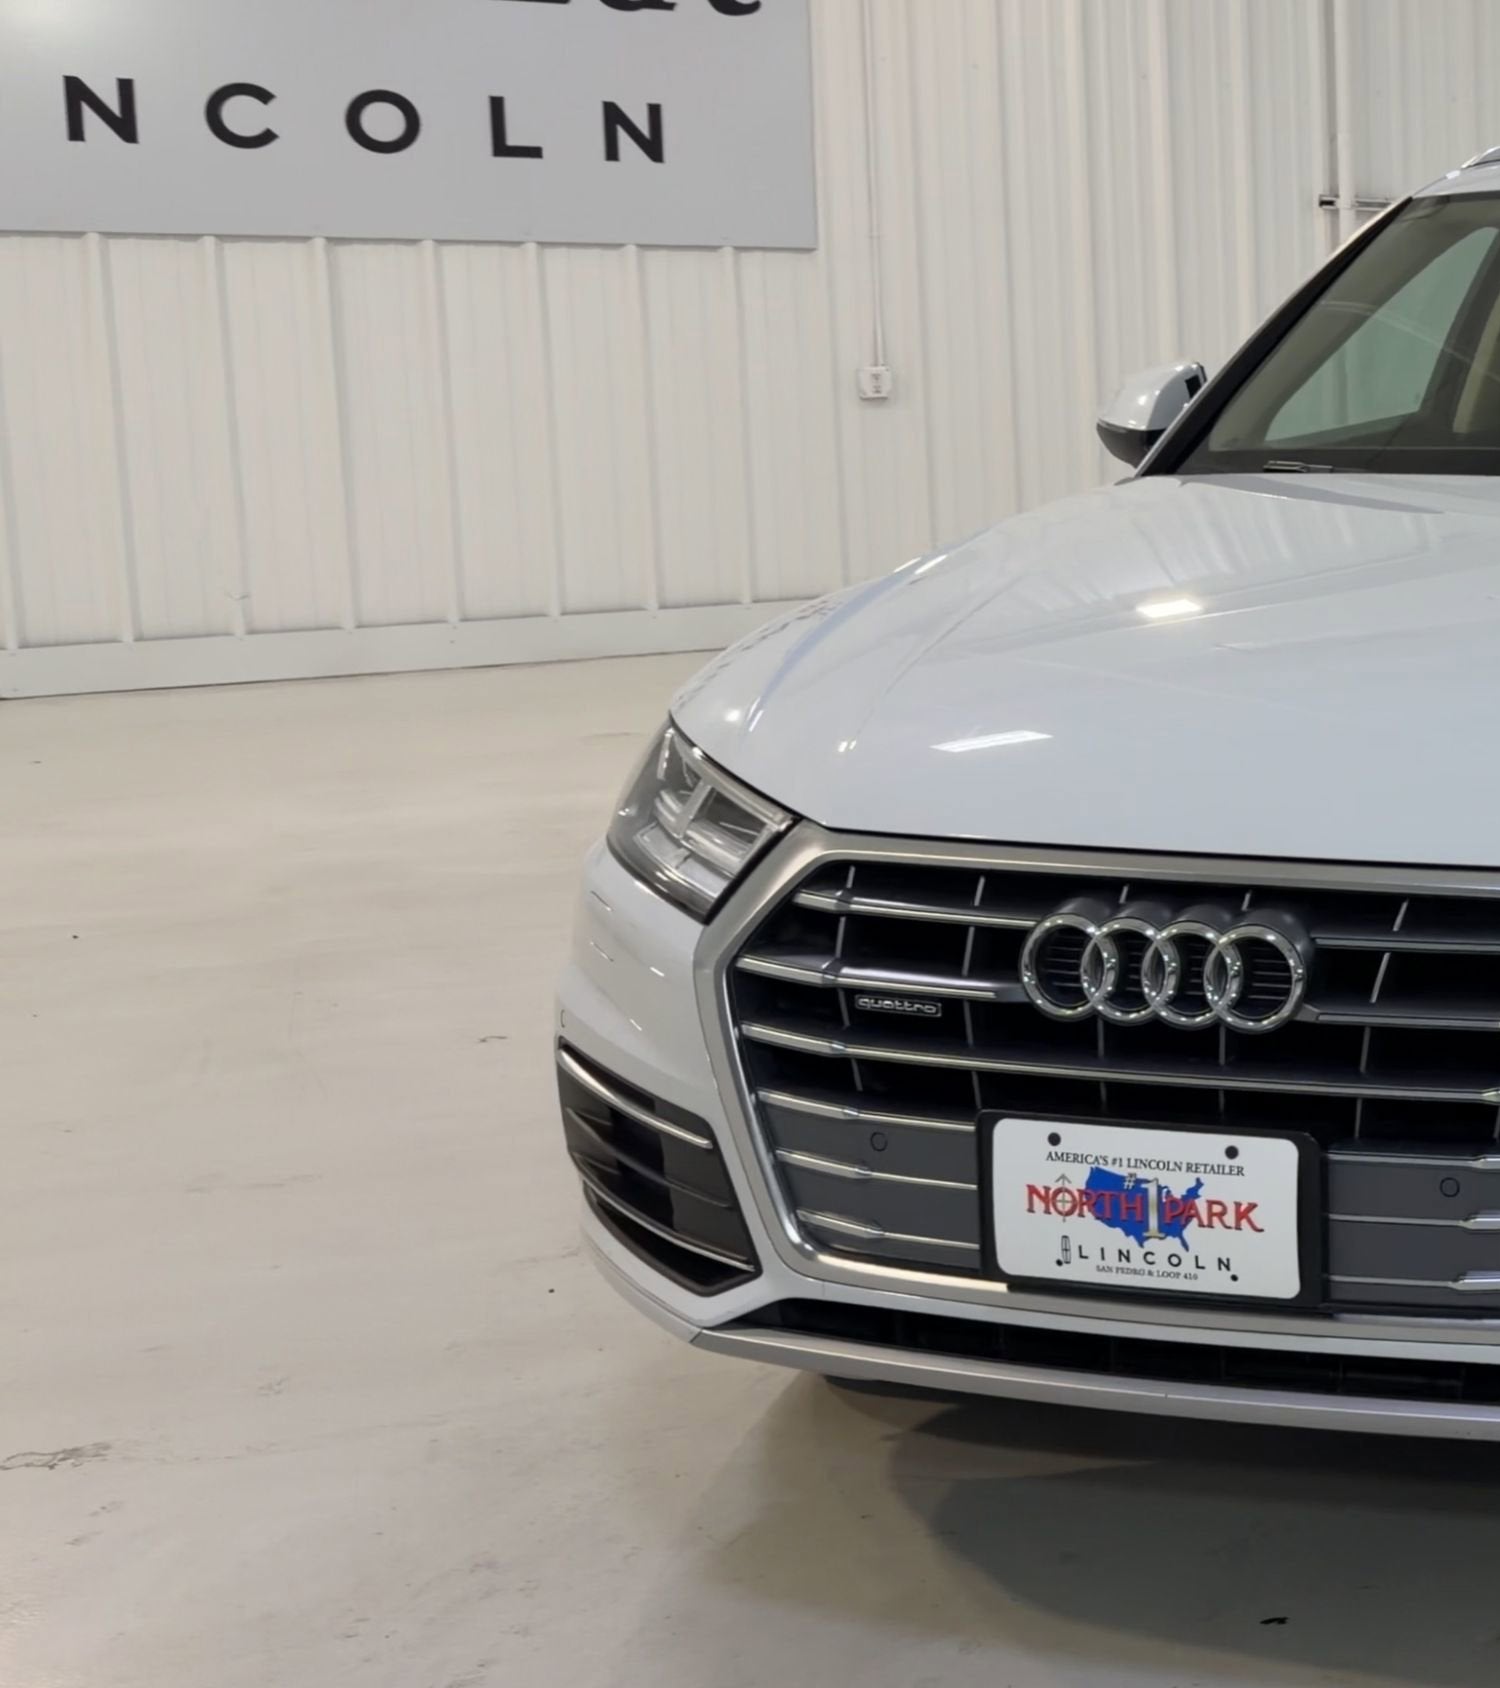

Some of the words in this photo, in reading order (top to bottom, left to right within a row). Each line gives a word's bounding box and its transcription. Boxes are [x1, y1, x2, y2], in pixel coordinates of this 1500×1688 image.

[858, 998, 937, 1014] quattro
[1046, 1151, 1109, 1167] AMERICA'S
[1111, 1157, 1123, 1168] #1
[1127, 1158, 1183, 1173] LINCOLN
[1186, 1162, 1245, 1177] RETAILER
[1026, 1184, 1145, 1223] NORTH
[1163, 1195, 1265, 1233] PARK
[1078, 1245, 1231, 1272] LINCOLN
[1096, 1265, 1113, 1273] SAN
[1115, 1266, 1145, 1276] PEDRO
[1156, 1270, 1181, 1279] LOOP
